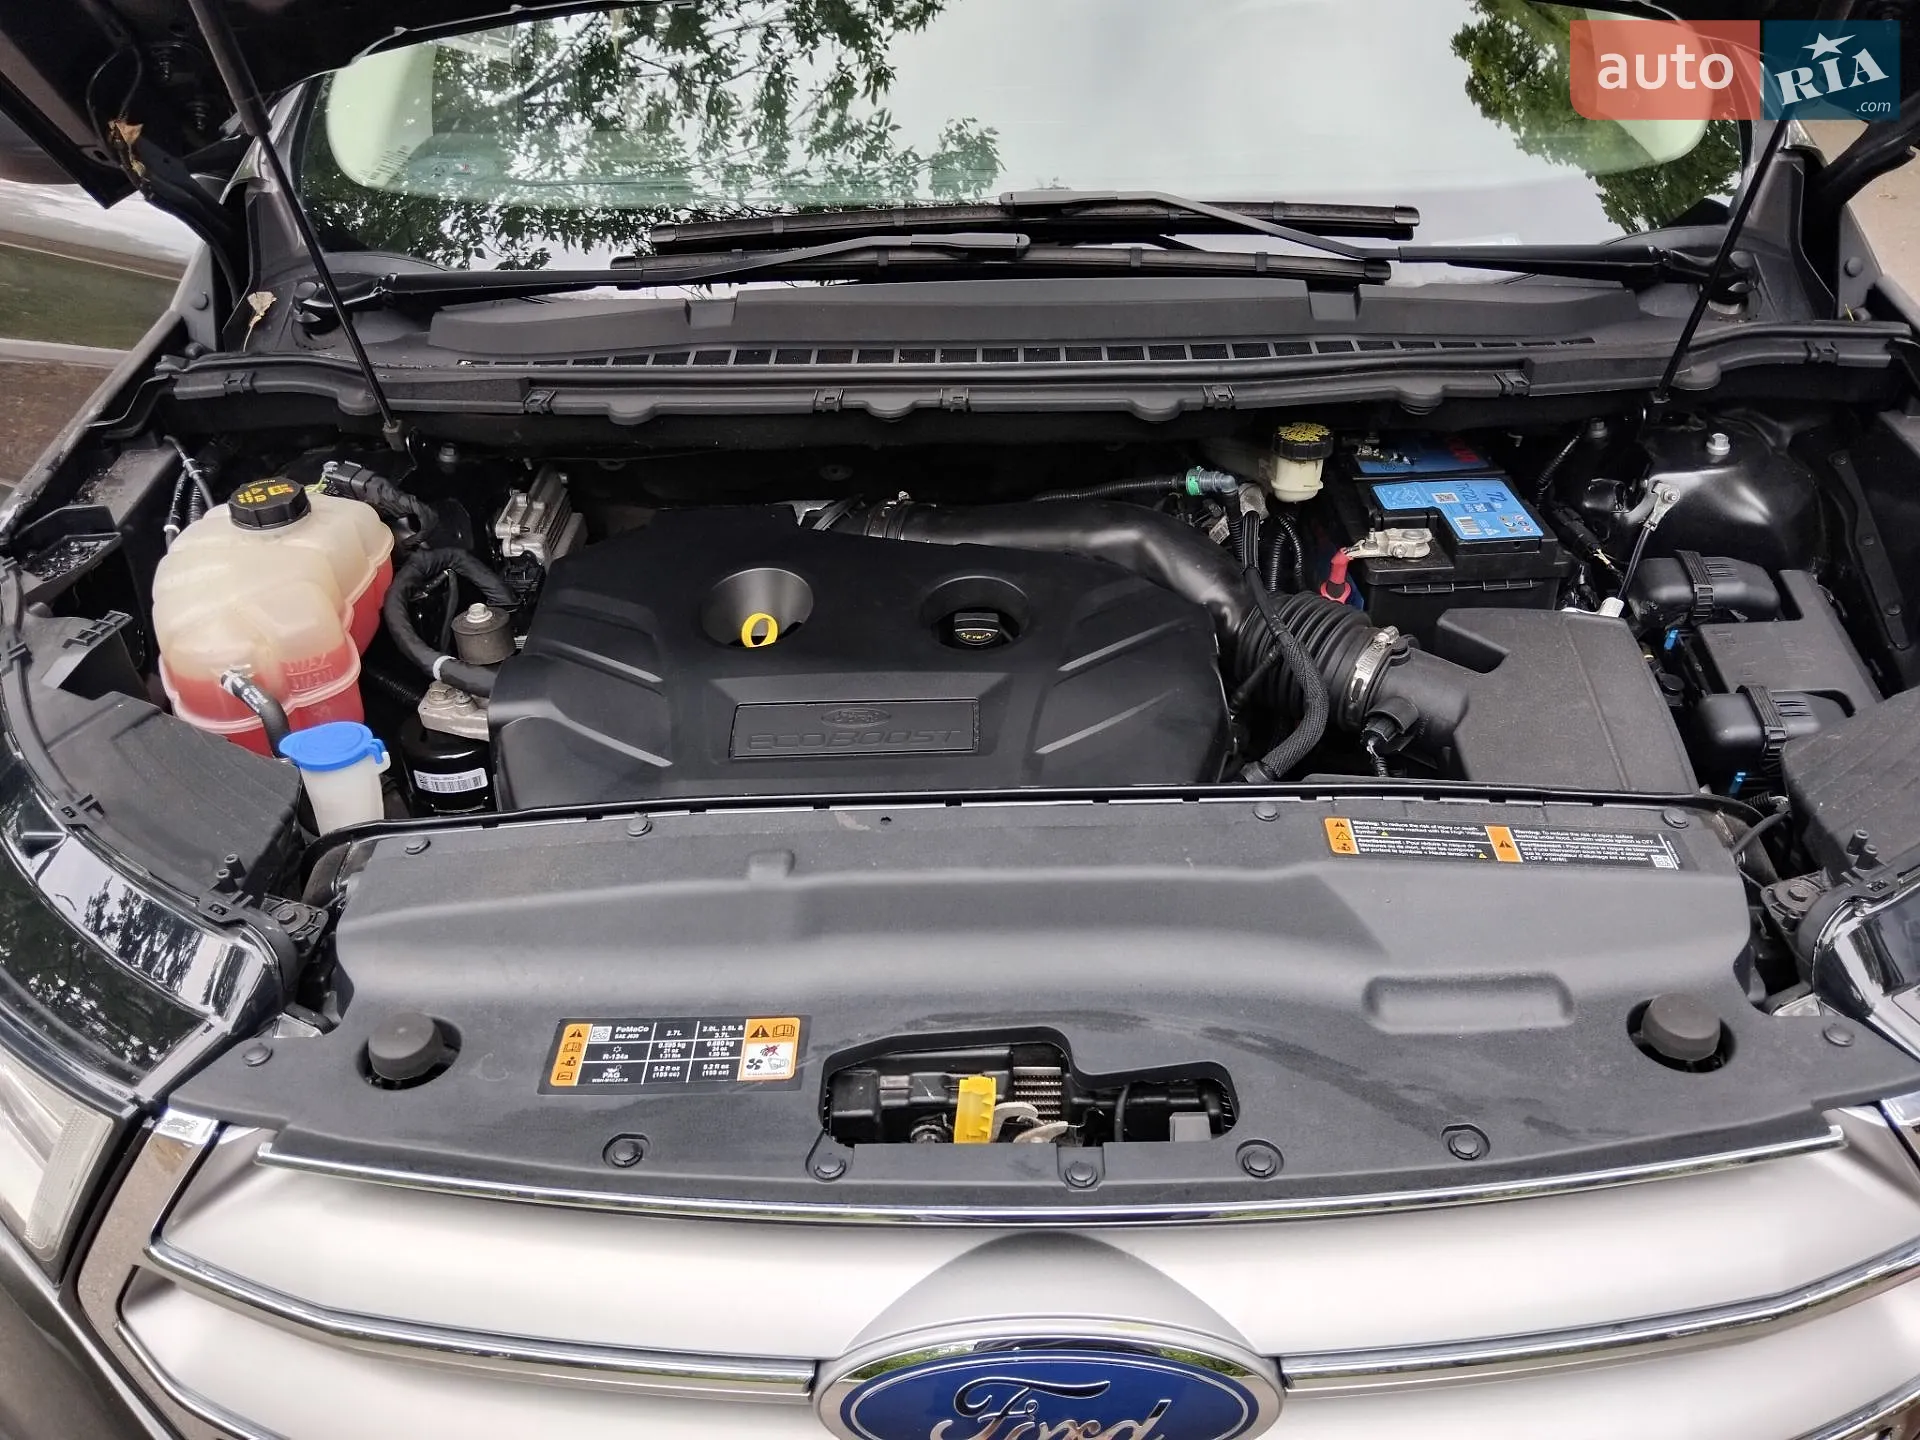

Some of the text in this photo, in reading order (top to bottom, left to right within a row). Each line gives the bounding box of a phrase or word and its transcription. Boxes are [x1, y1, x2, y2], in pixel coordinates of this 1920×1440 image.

[747, 730, 961, 751] ECOBOOST
[615, 1025, 650, 1033] FoMoCo
[666, 1029, 683, 1037] 2.7L
[929, 1376, 1173, 1440] Ford
